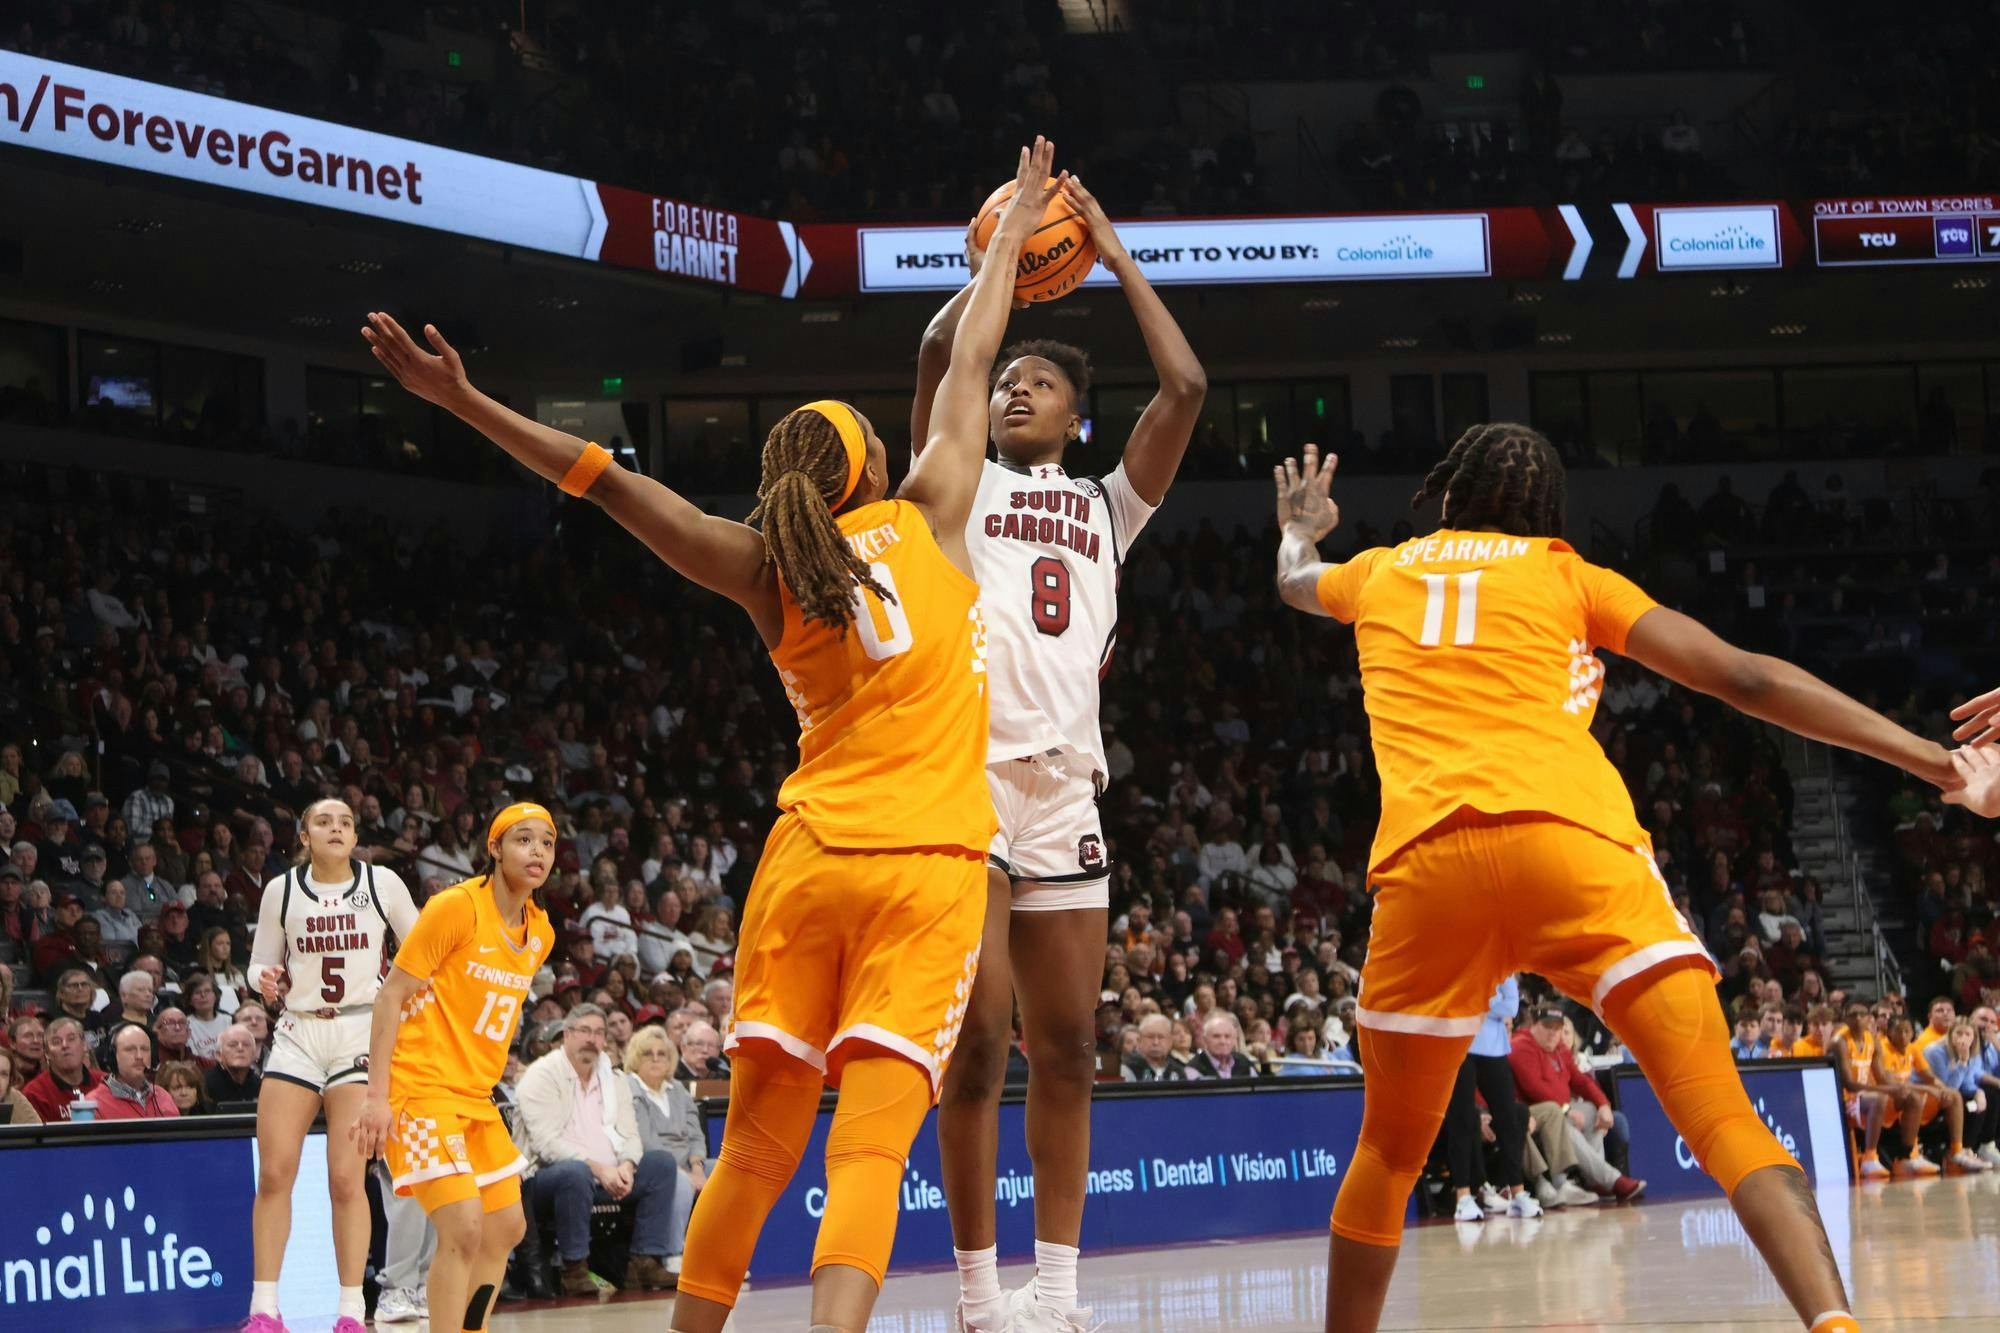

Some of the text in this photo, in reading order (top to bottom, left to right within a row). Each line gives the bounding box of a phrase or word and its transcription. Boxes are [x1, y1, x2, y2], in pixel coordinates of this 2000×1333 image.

[652, 198, 738, 245] FOREVER
[1814, 197, 1993, 215] OUT OF TOWN SCORES
[1337, 245, 1434, 262] Colonial Life
[1669, 236, 1765, 252] Colonial Life
[1859, 232, 1897, 247] TCU
[1940, 228, 1969, 244] TCU
[654, 229, 738, 285] GARNET
[896, 253, 968, 269] HUSTL
[1189, 247, 1221, 262] TO
[1226, 245, 1275, 261] YOU
[1281, 244, 1318, 260] BY:
[1016, 236, 1076, 280] ilson
[1010, 490, 1090, 524] SOUTH
[984, 514, 1100, 564] CAROLINA
[1394, 539, 1530, 566] SPEARMAN
[849, 561, 914, 660] 0
[1030, 555, 1071, 638] 8
[1419, 569, 1483, 646] 11
[296, 932, 369, 954] CAROLINA
[306, 913, 356, 933] SOUTH
[321, 957, 345, 1003] 5
[473, 991, 517, 1042] 13
[1153, 1156, 1214, 1188] Dental
[1231, 1152, 1287, 1182] Vision
[1302, 1148, 1336, 1177] Life
[0, 1239, 106, 1304] nial
